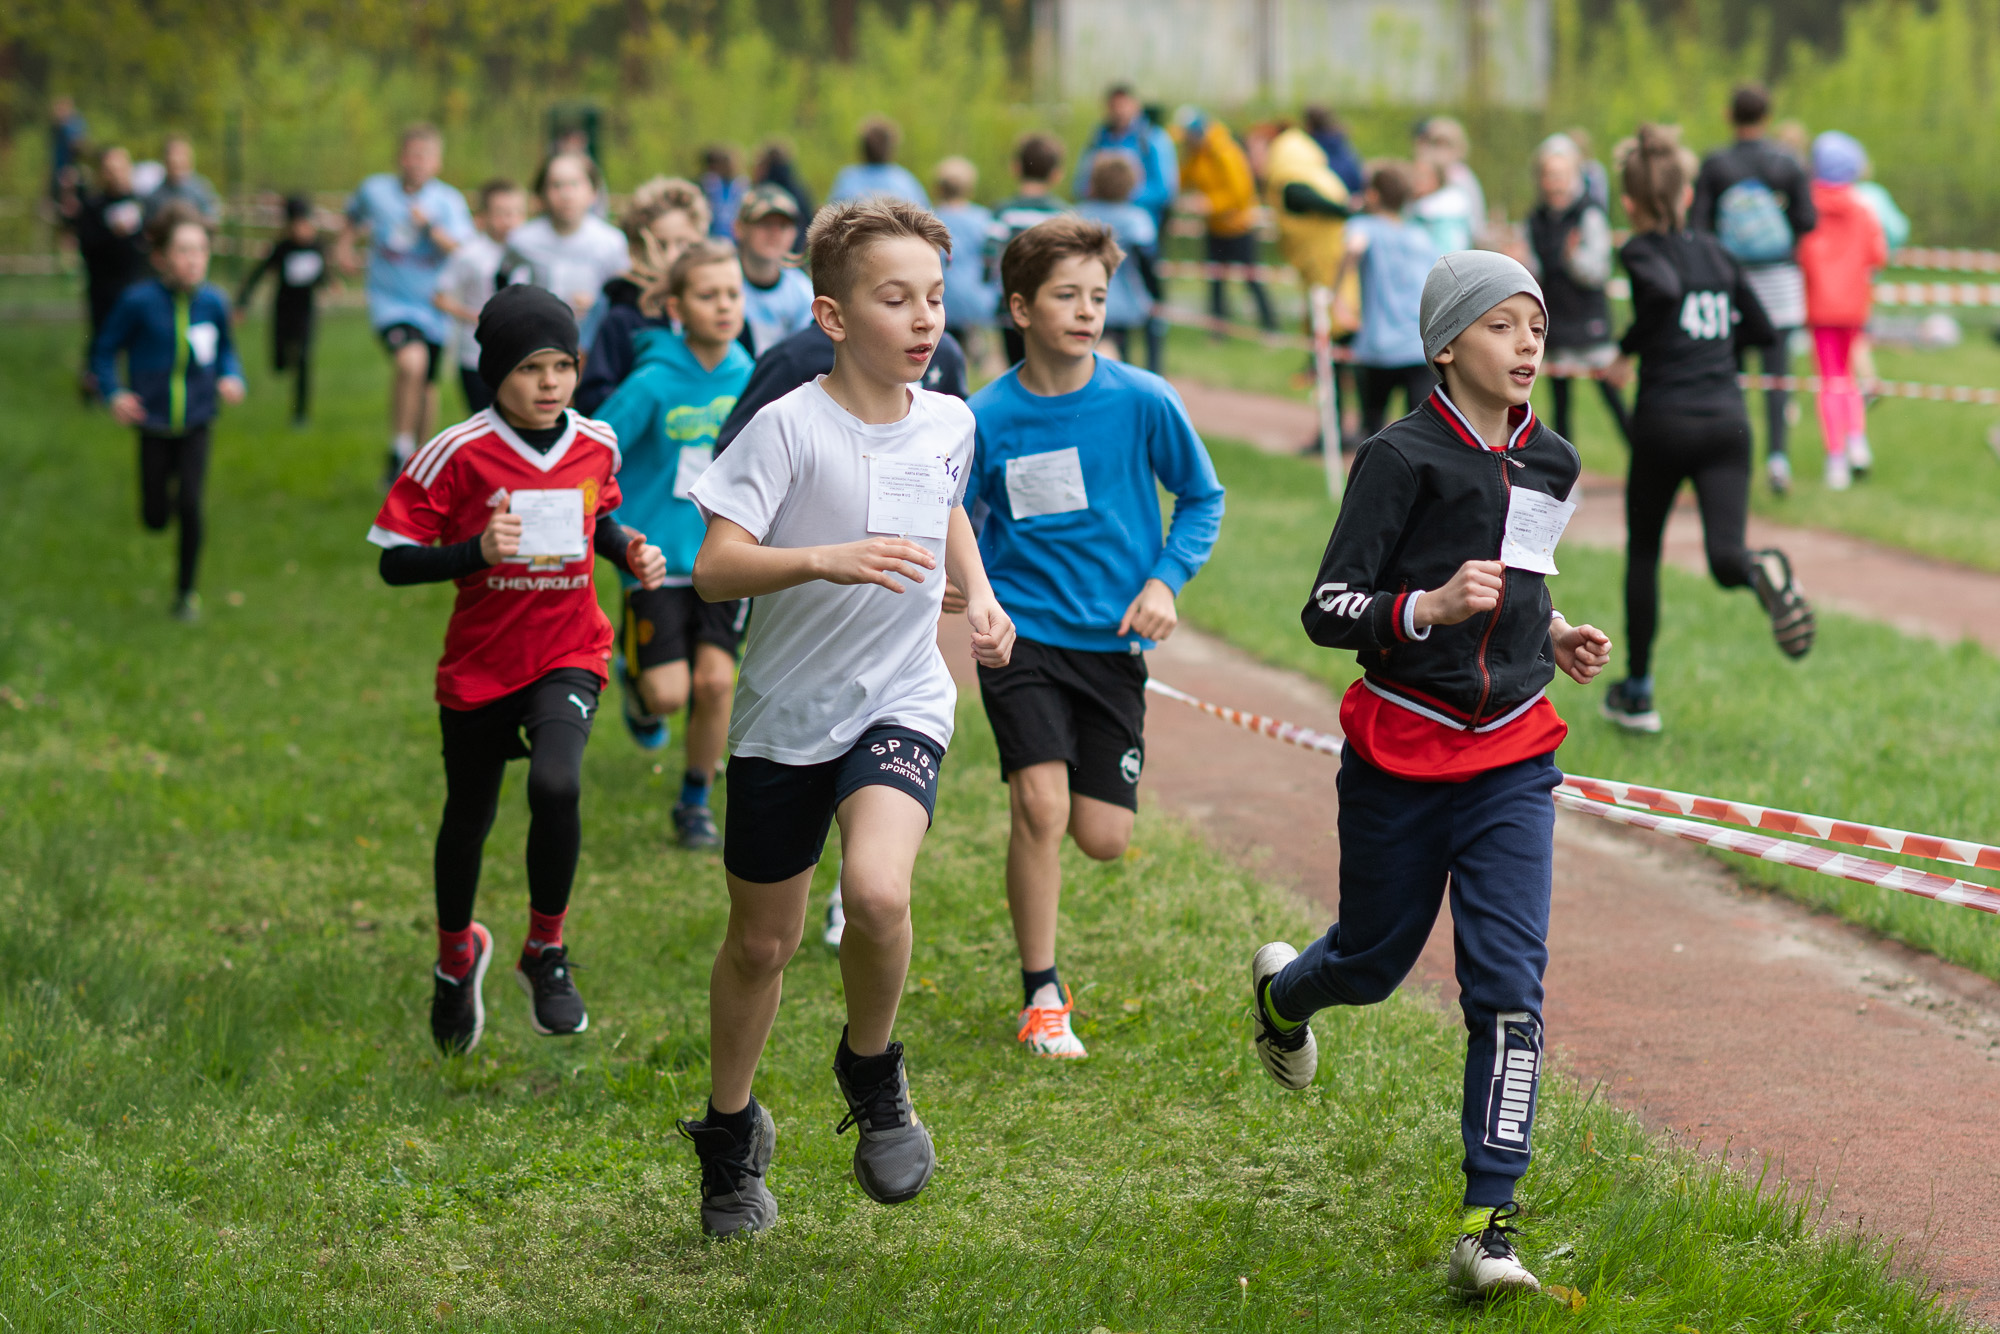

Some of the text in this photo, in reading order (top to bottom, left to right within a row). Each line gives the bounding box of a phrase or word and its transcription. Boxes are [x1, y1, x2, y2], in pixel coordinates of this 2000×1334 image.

[1679, 290, 1730, 340] 431
[487, 574, 589, 591] CHEVROLET
[871, 740, 936, 780] SP 154
[880, 763, 926, 790] SPORTOWA
[893, 757, 921, 777] KLASA
[1497, 1049, 1535, 1142] PUMA
